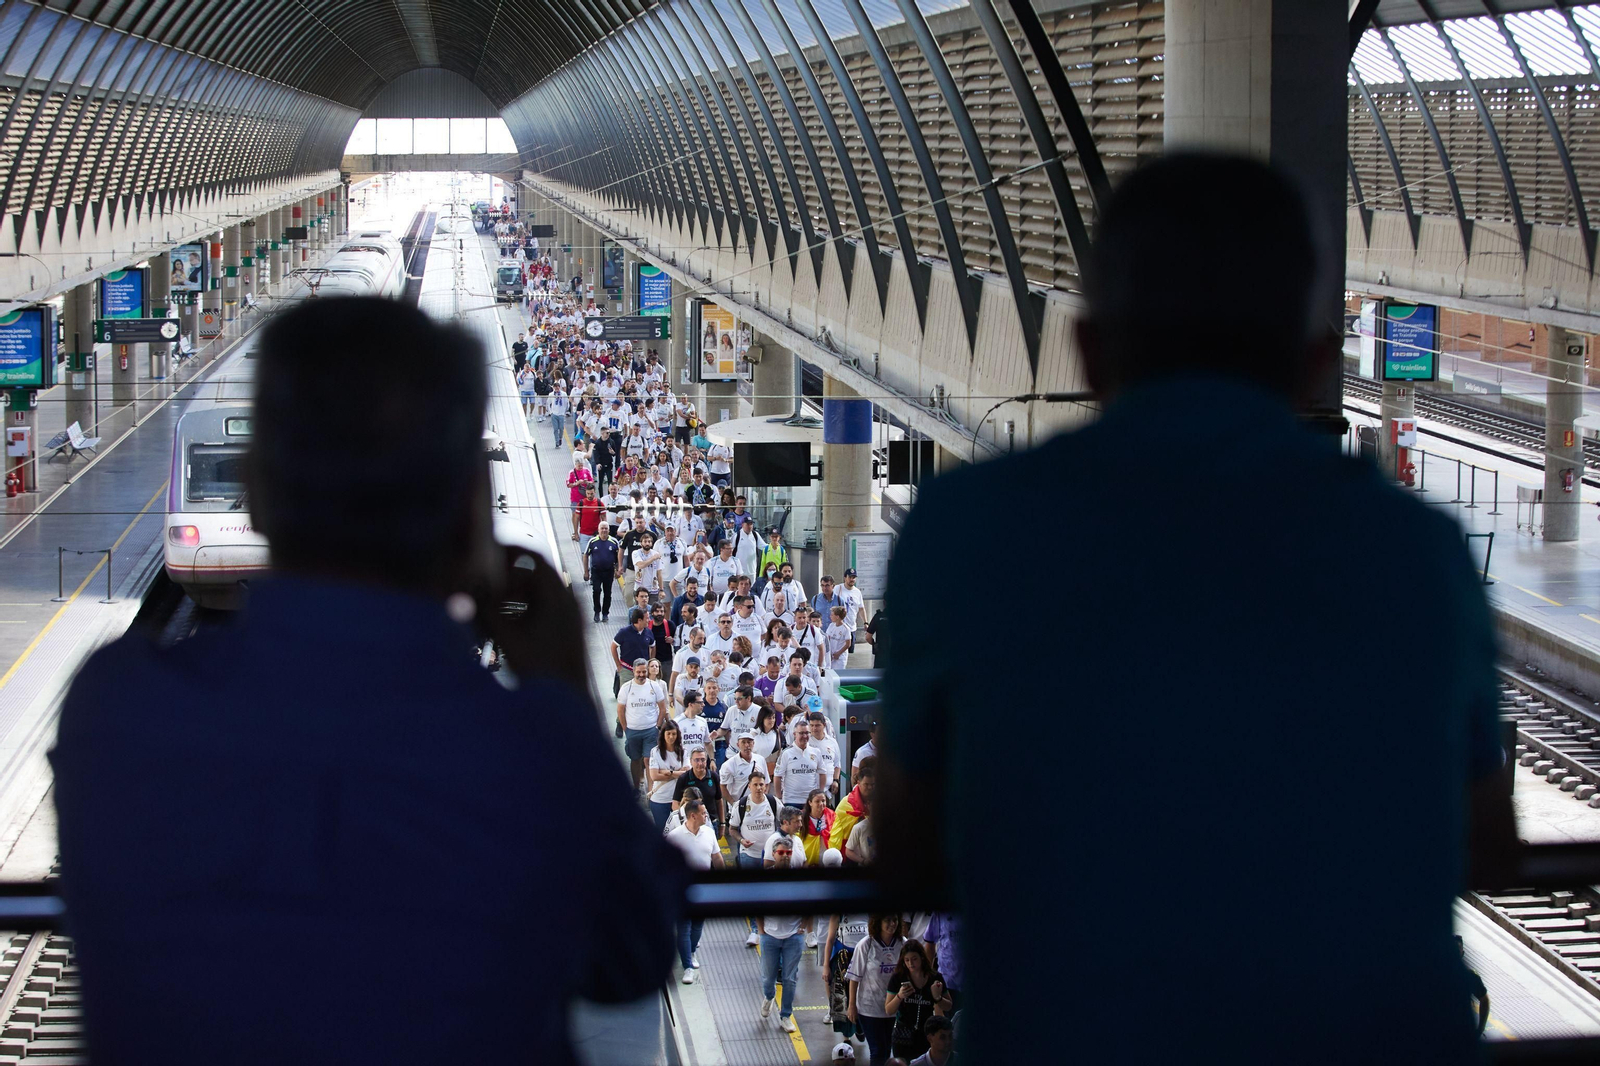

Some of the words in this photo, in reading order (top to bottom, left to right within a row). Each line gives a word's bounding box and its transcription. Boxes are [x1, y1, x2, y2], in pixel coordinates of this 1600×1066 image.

[104, 331, 111, 341] 6
[655, 327, 661, 338] 5
[86, 356, 93, 368] E
[30, 393, 38, 407] D
[609, 417, 620, 429] 14
[904, 998, 932, 1006] Emirates
[914, 993, 923, 1001] Fly
